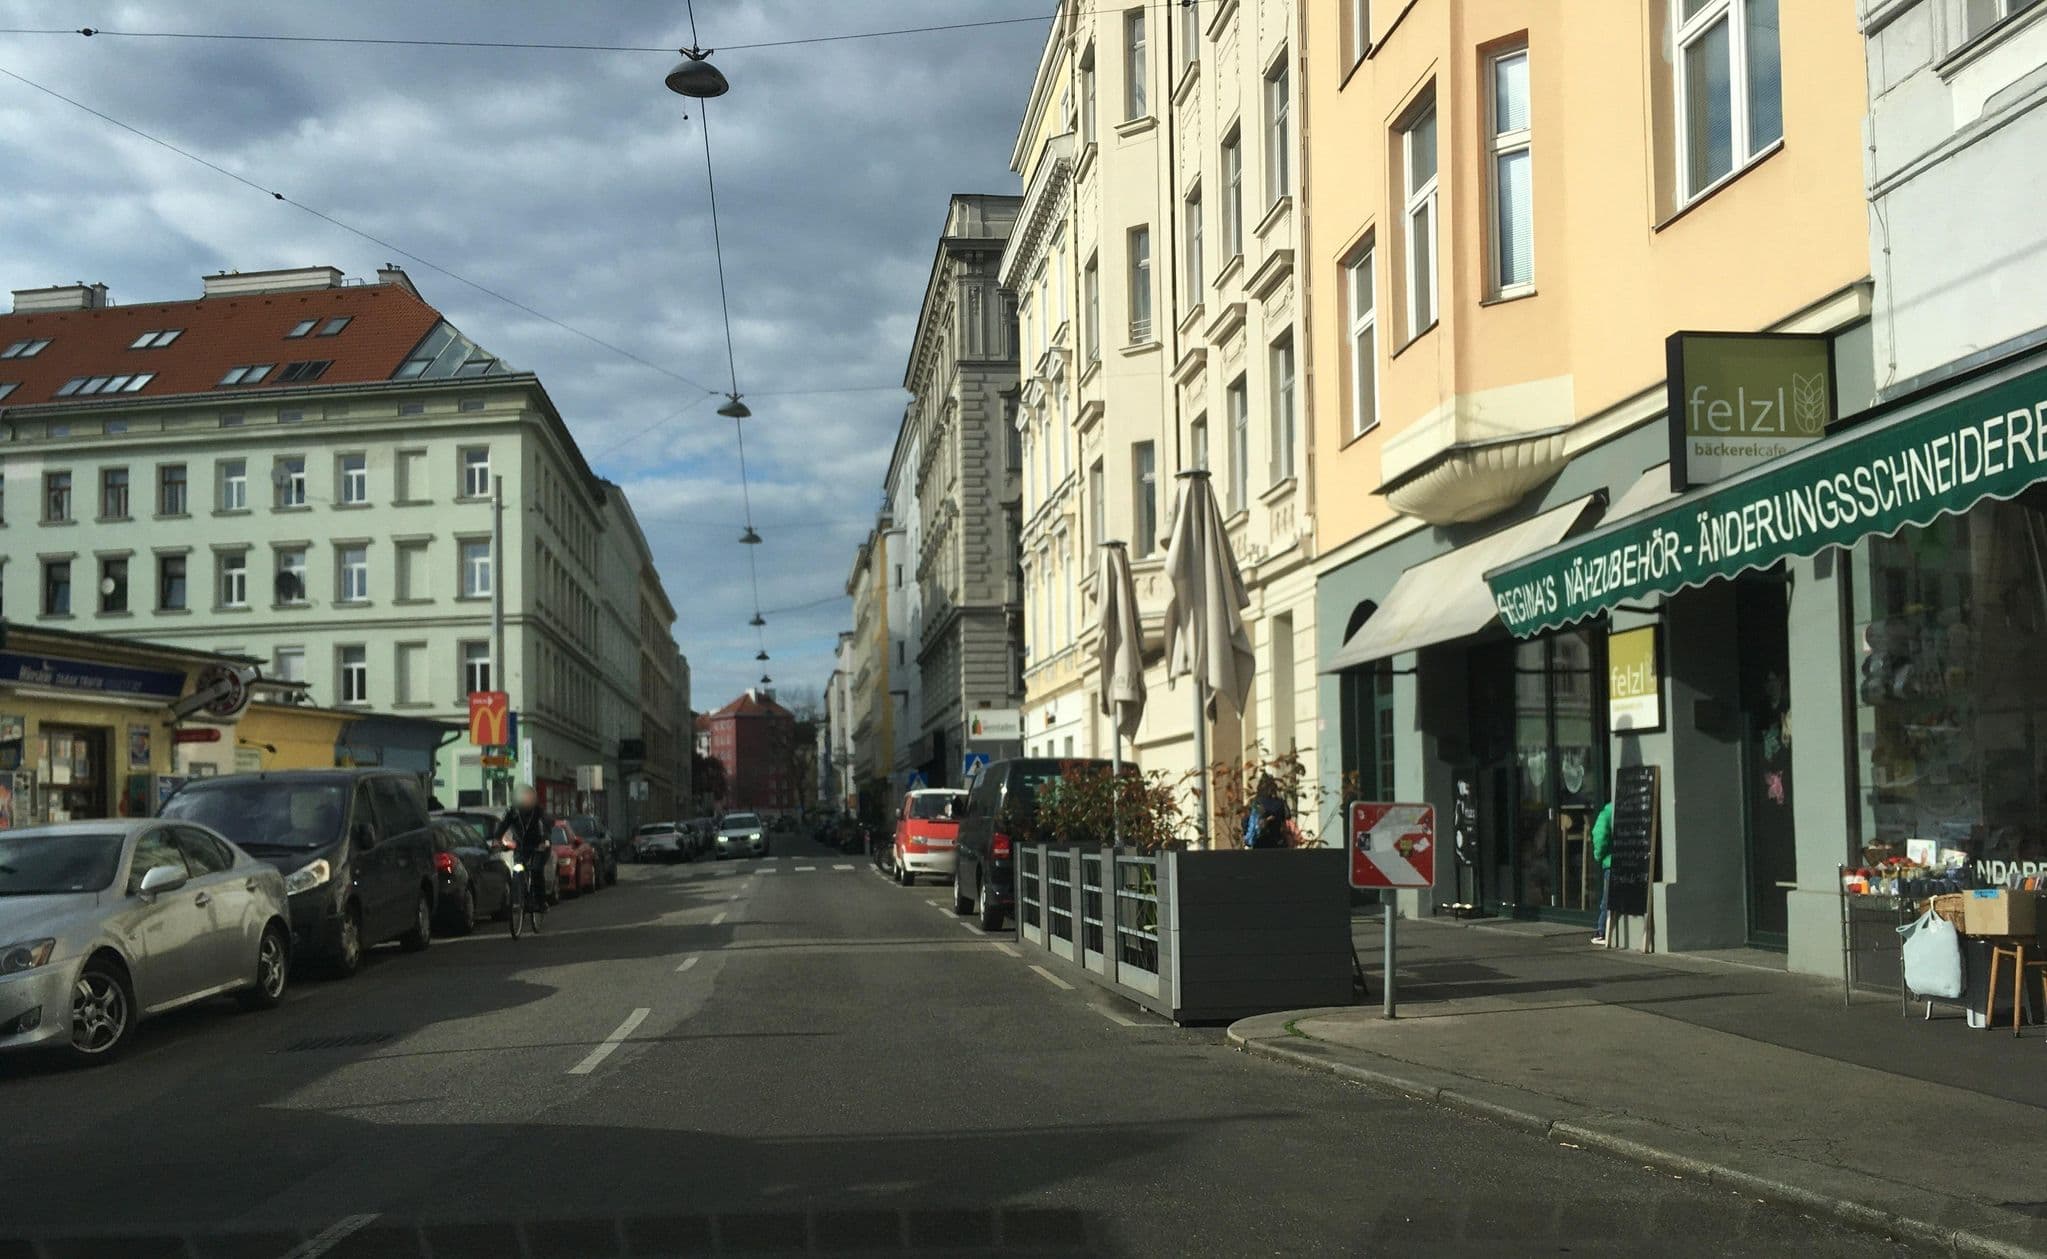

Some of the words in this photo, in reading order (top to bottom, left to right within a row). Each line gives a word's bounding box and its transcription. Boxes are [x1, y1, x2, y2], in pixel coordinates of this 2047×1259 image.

[1689, 385, 1786, 433] felzl
[1496, 574, 1558, 626] REGINA'S
[1563, 527, 1682, 608] NÄHZUBEHÖR
[1611, 661, 1645, 697] felzl
